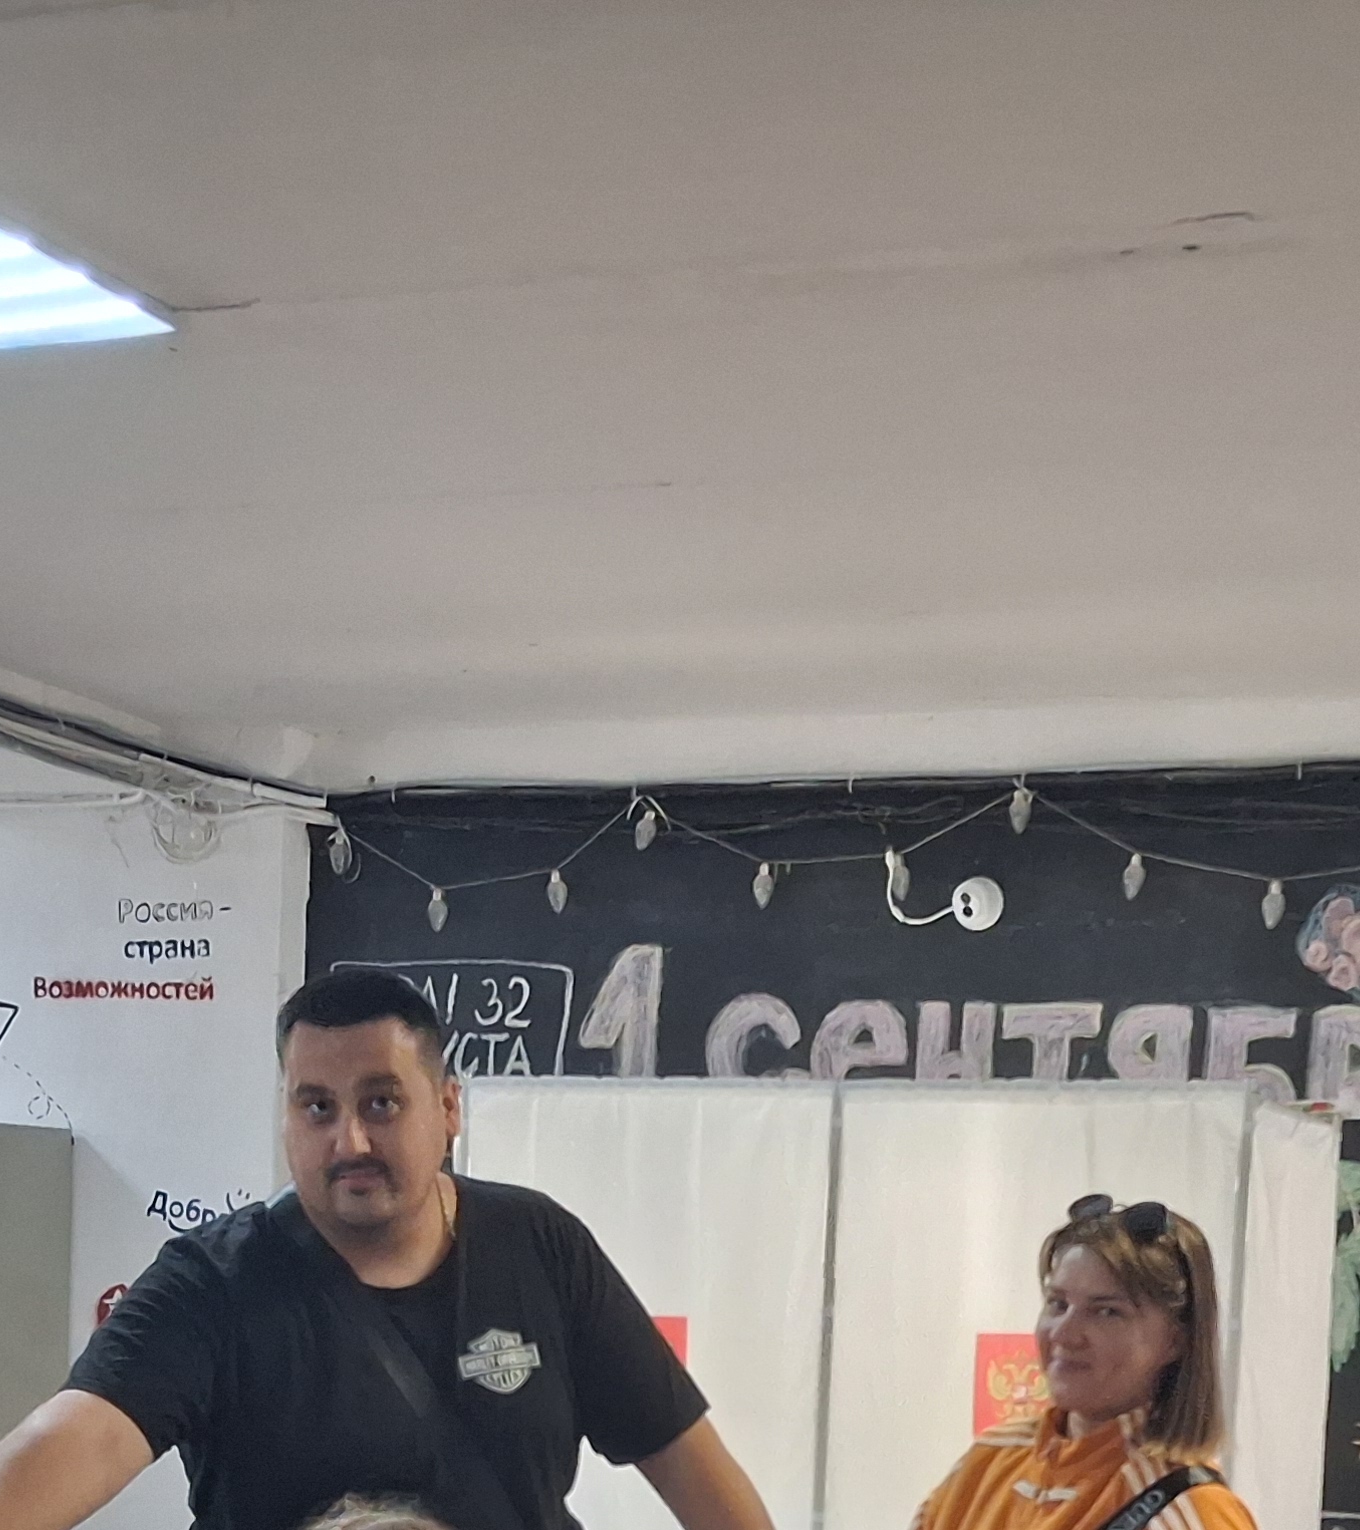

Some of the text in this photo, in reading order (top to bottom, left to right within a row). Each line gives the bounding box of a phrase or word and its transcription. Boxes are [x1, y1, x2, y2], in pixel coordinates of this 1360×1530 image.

[124, 938, 211, 964] страна
[33, 976, 214, 1001] Возможностей
[474, 975, 532, 1028] 32
[578, 943, 662, 1078] 1
